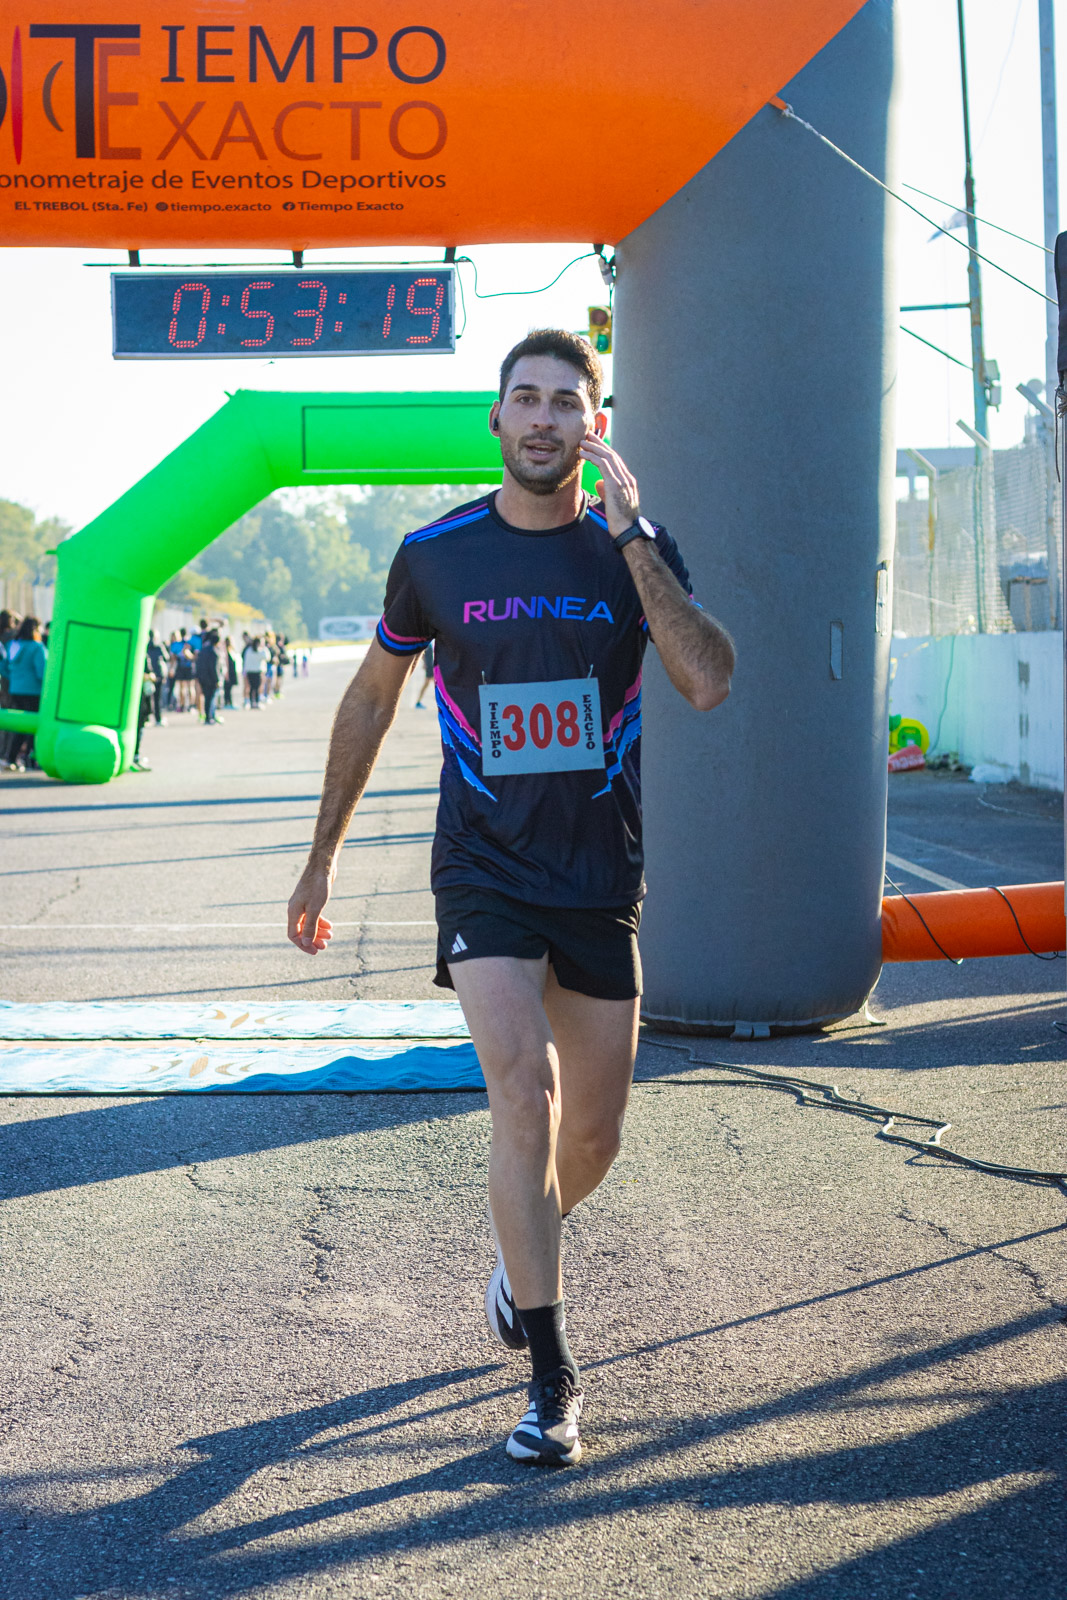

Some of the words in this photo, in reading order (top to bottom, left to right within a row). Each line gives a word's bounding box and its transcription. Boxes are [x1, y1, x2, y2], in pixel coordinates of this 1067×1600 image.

[151, 169, 183, 189] de
[191, 170, 293, 189] Eventos
[302, 169, 446, 193] Deportivos
[14, 201, 31, 211] EL
[33, 201, 89, 211] TREBOL
[92, 201, 124, 212] (Sta.
[127, 201, 148, 212] Fe)
[298, 201, 353, 213] Tiempo
[356, 201, 404, 211] Exacto
[463, 595, 615, 625] RUNNEA
[488, 701, 502, 759] TIEMPO
[501, 700, 581, 752] 308
[582, 694, 596, 751] EXACTO
